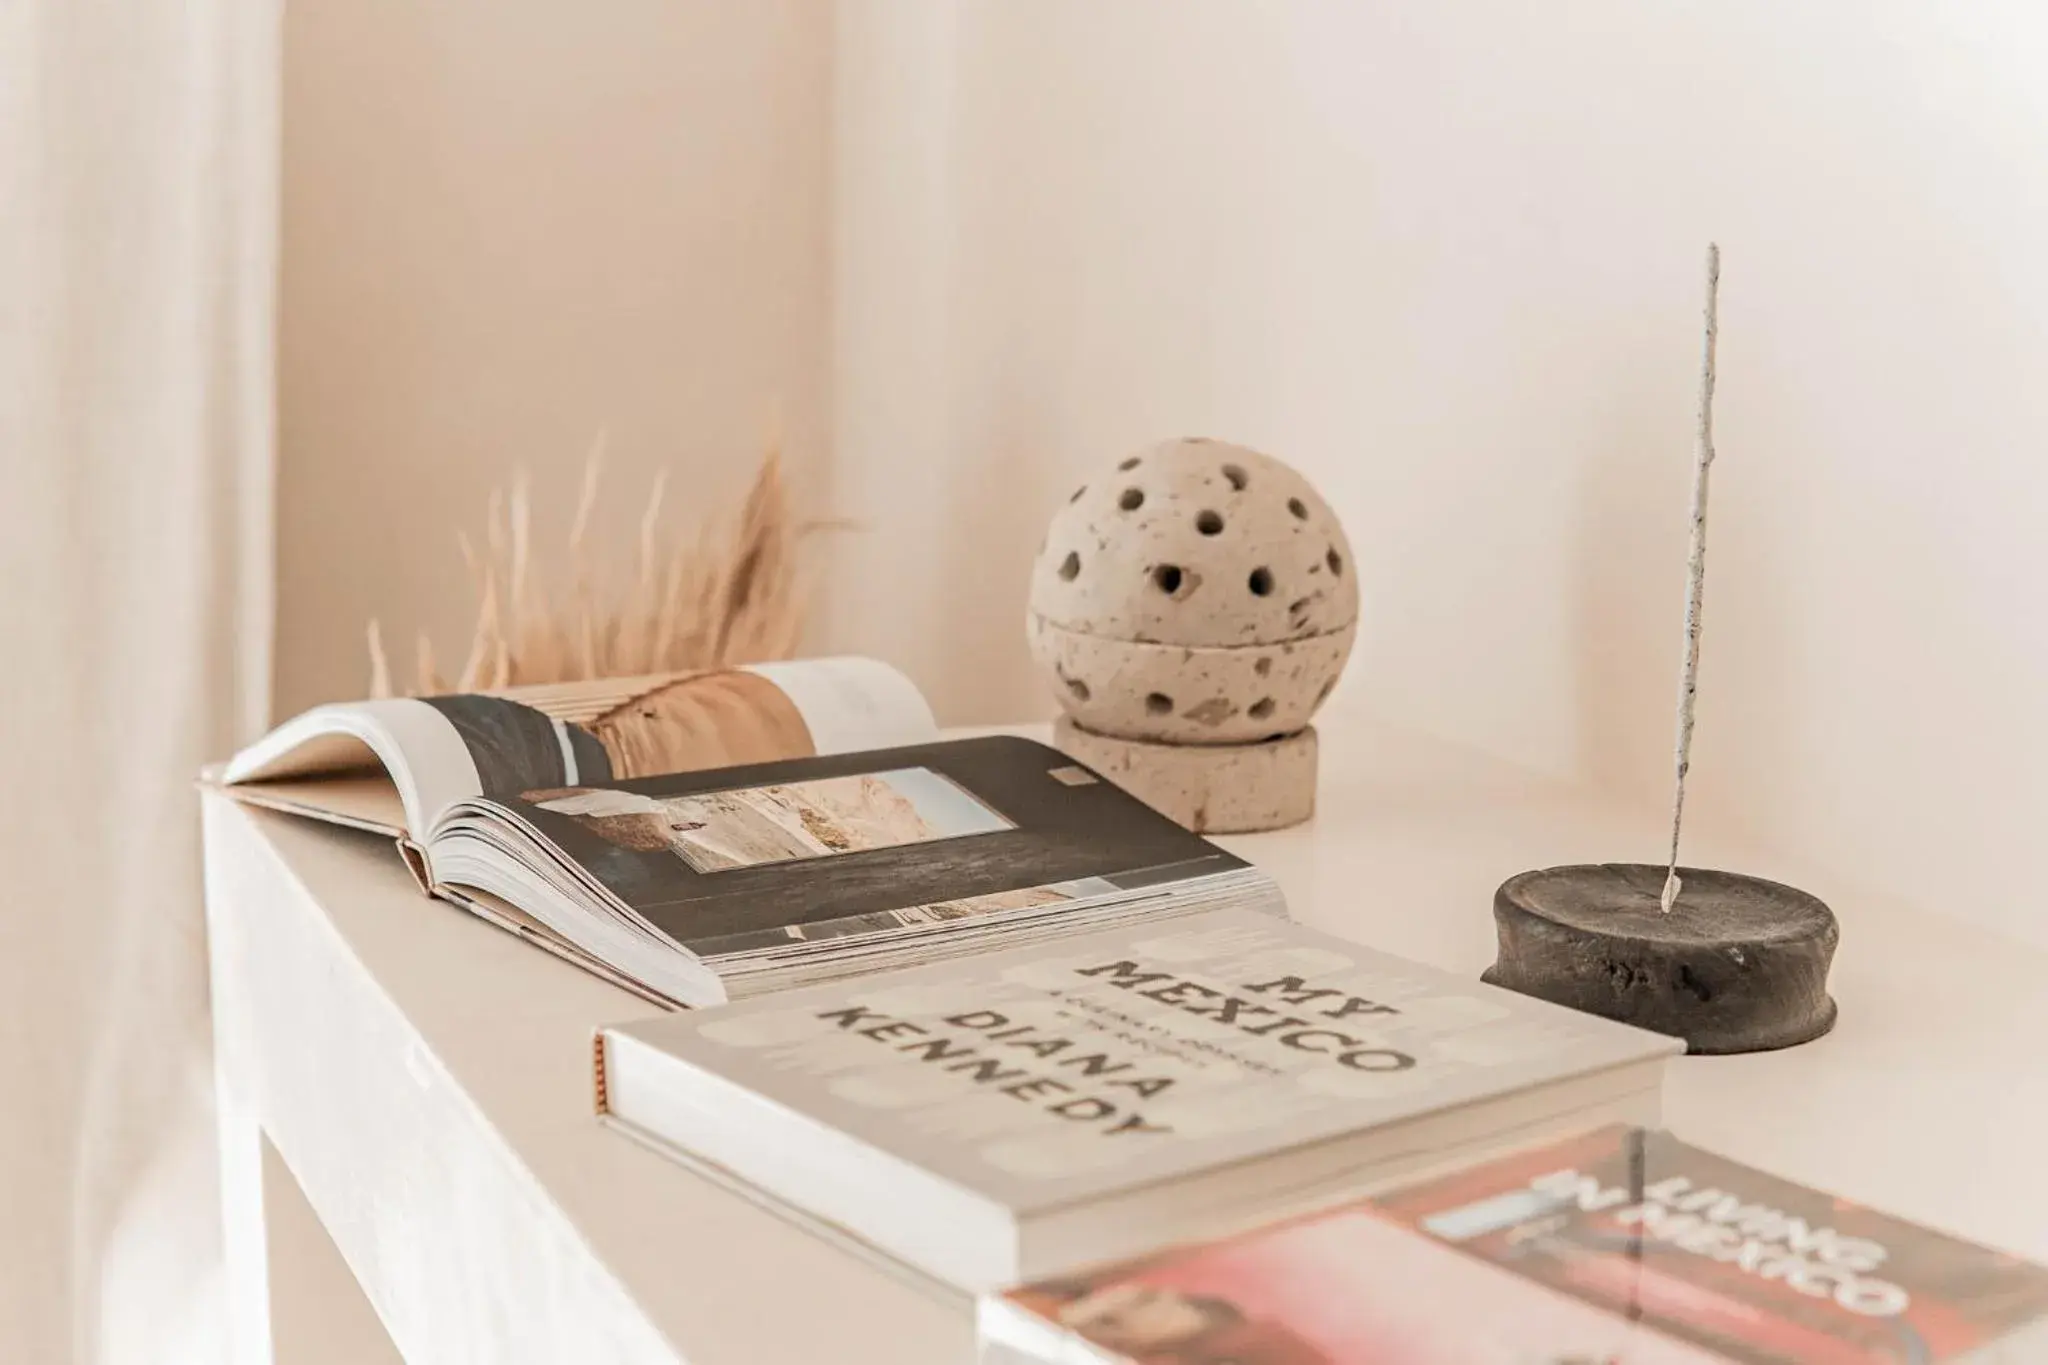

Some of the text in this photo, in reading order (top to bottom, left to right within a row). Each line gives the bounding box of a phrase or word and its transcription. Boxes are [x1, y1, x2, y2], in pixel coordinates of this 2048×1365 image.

[1075, 959, 1418, 1074] MEXICO
[1242, 975, 1401, 1019] MY
[815, 1005, 1175, 1136] KENNEDY
[944, 1009, 1177, 1101] DIANA
[1614, 1203, 1910, 1316] MEXICO
[1644, 1176, 1888, 1273] LIVING
